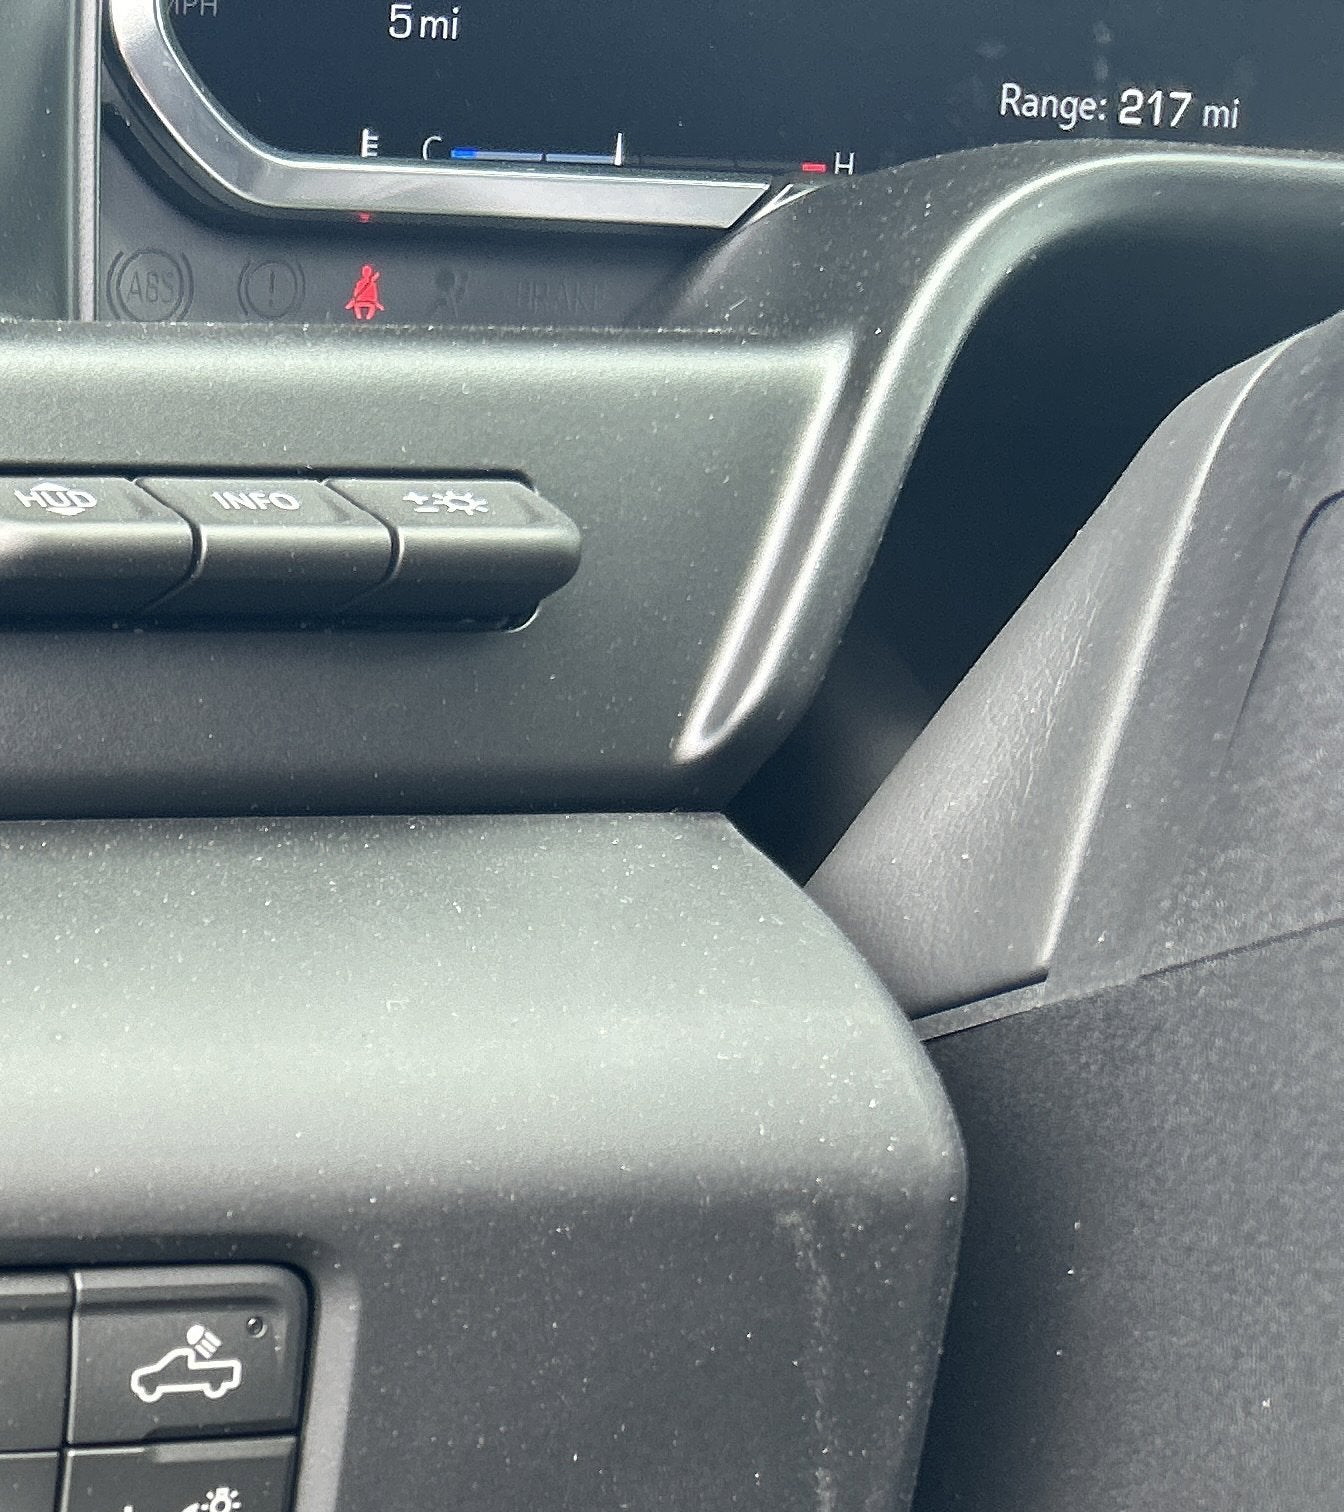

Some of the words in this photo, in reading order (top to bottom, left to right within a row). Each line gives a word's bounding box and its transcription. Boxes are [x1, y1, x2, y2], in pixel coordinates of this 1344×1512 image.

[388, 3, 413, 40] 5
[419, 7, 460, 40] mi
[999, 81, 1107, 132] Range:
[1117, 87, 1195, 128] 217
[1202, 97, 1241, 129] mi
[360, 127, 380, 158] E
[832, 151, 856, 176] H
[126, 270, 175, 304] ABS
[211, 489, 303, 511] INFO
